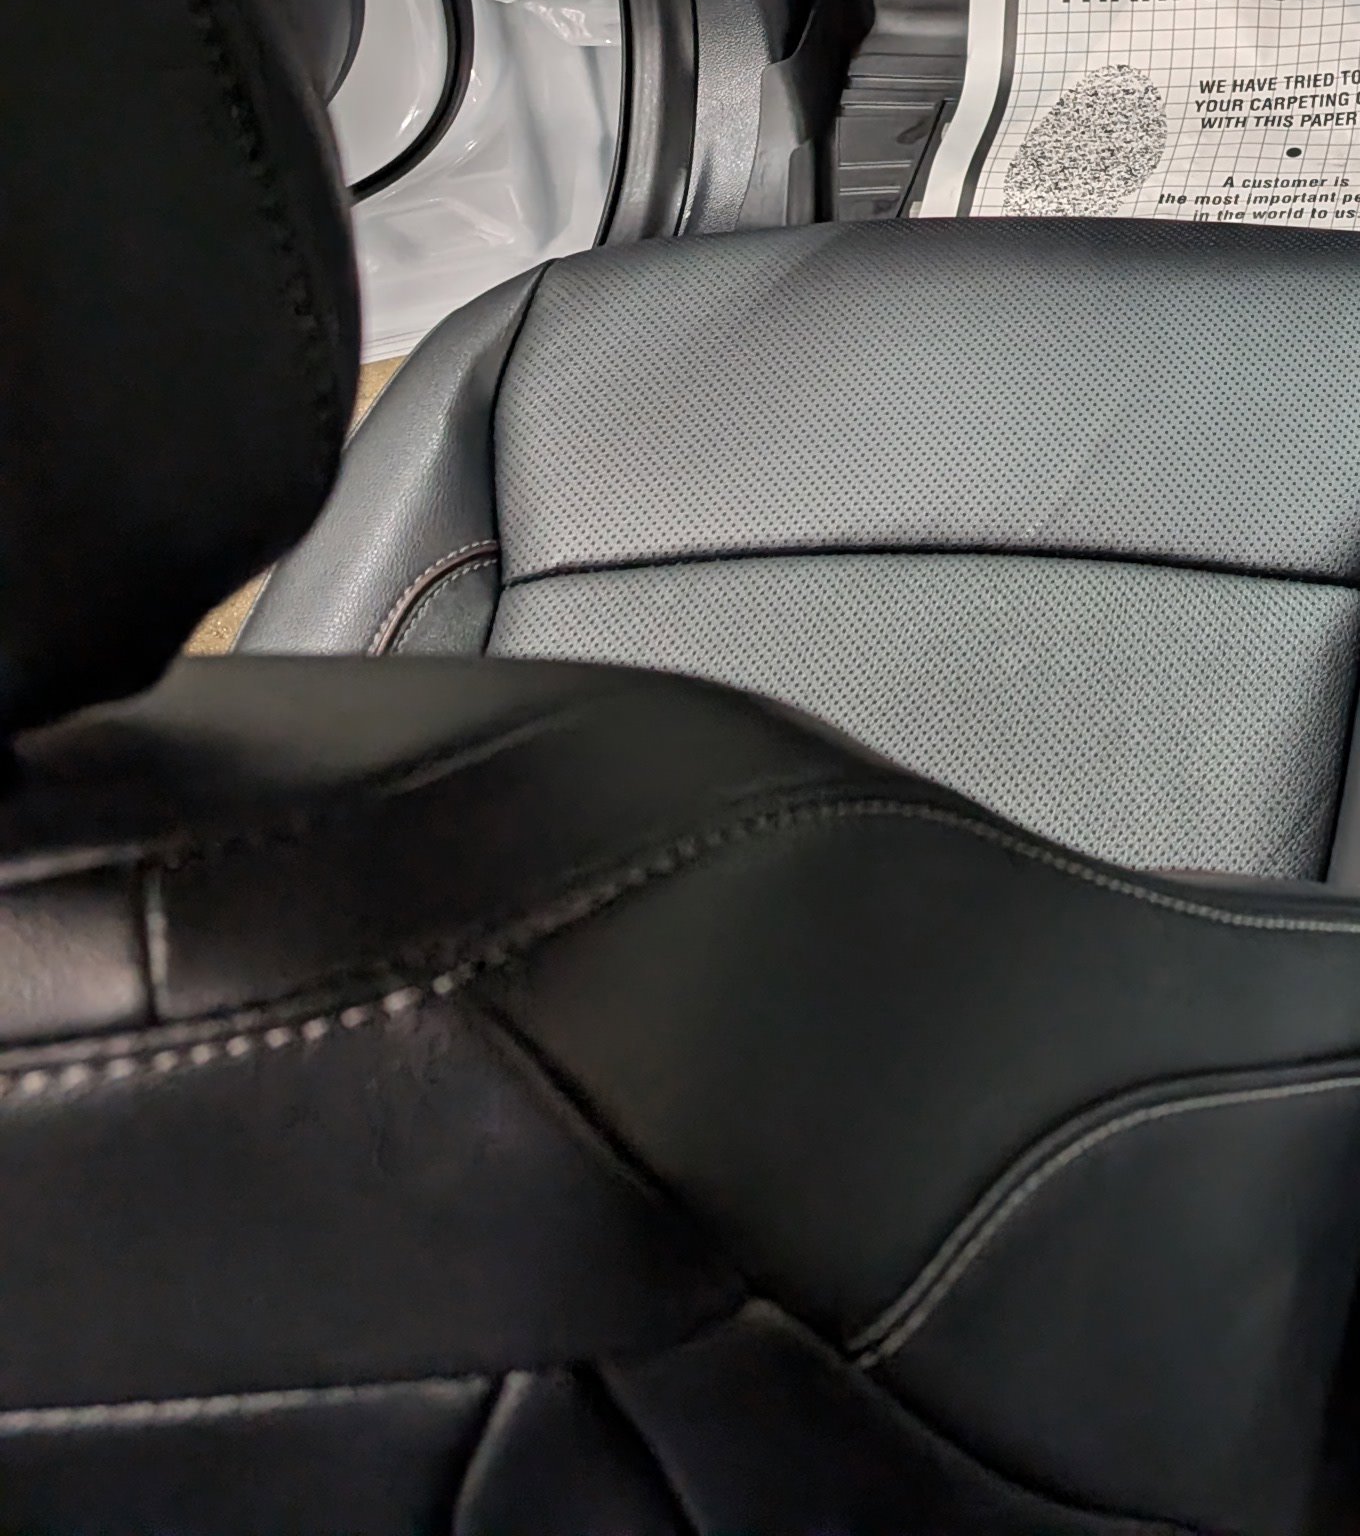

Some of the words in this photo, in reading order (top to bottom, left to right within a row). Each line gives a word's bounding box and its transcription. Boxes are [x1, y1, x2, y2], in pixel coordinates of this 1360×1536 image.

[1199, 79, 1227, 94] WE
[1232, 76, 1278, 93] HAVE
[1283, 72, 1335, 90] TRIED
[1195, 99, 1244, 113] YOUR
[1250, 92, 1349, 112] CARPETING
[1200, 115, 1248, 129] WITH
[1254, 115, 1294, 128] THIS
[1300, 112, 1357, 128] PAPER
[1222, 176, 1235, 188] A
[1242, 176, 1328, 188] customer
[1334, 176, 1349, 187] is
[1158, 193, 1187, 205] the
[1194, 194, 1240, 205] most
[1246, 192, 1336, 206] important
[1193, 210, 1209, 221] in
[1217, 209, 1245, 222] the
[1252, 207, 1304, 221] world
[1311, 208, 1328, 219] to
